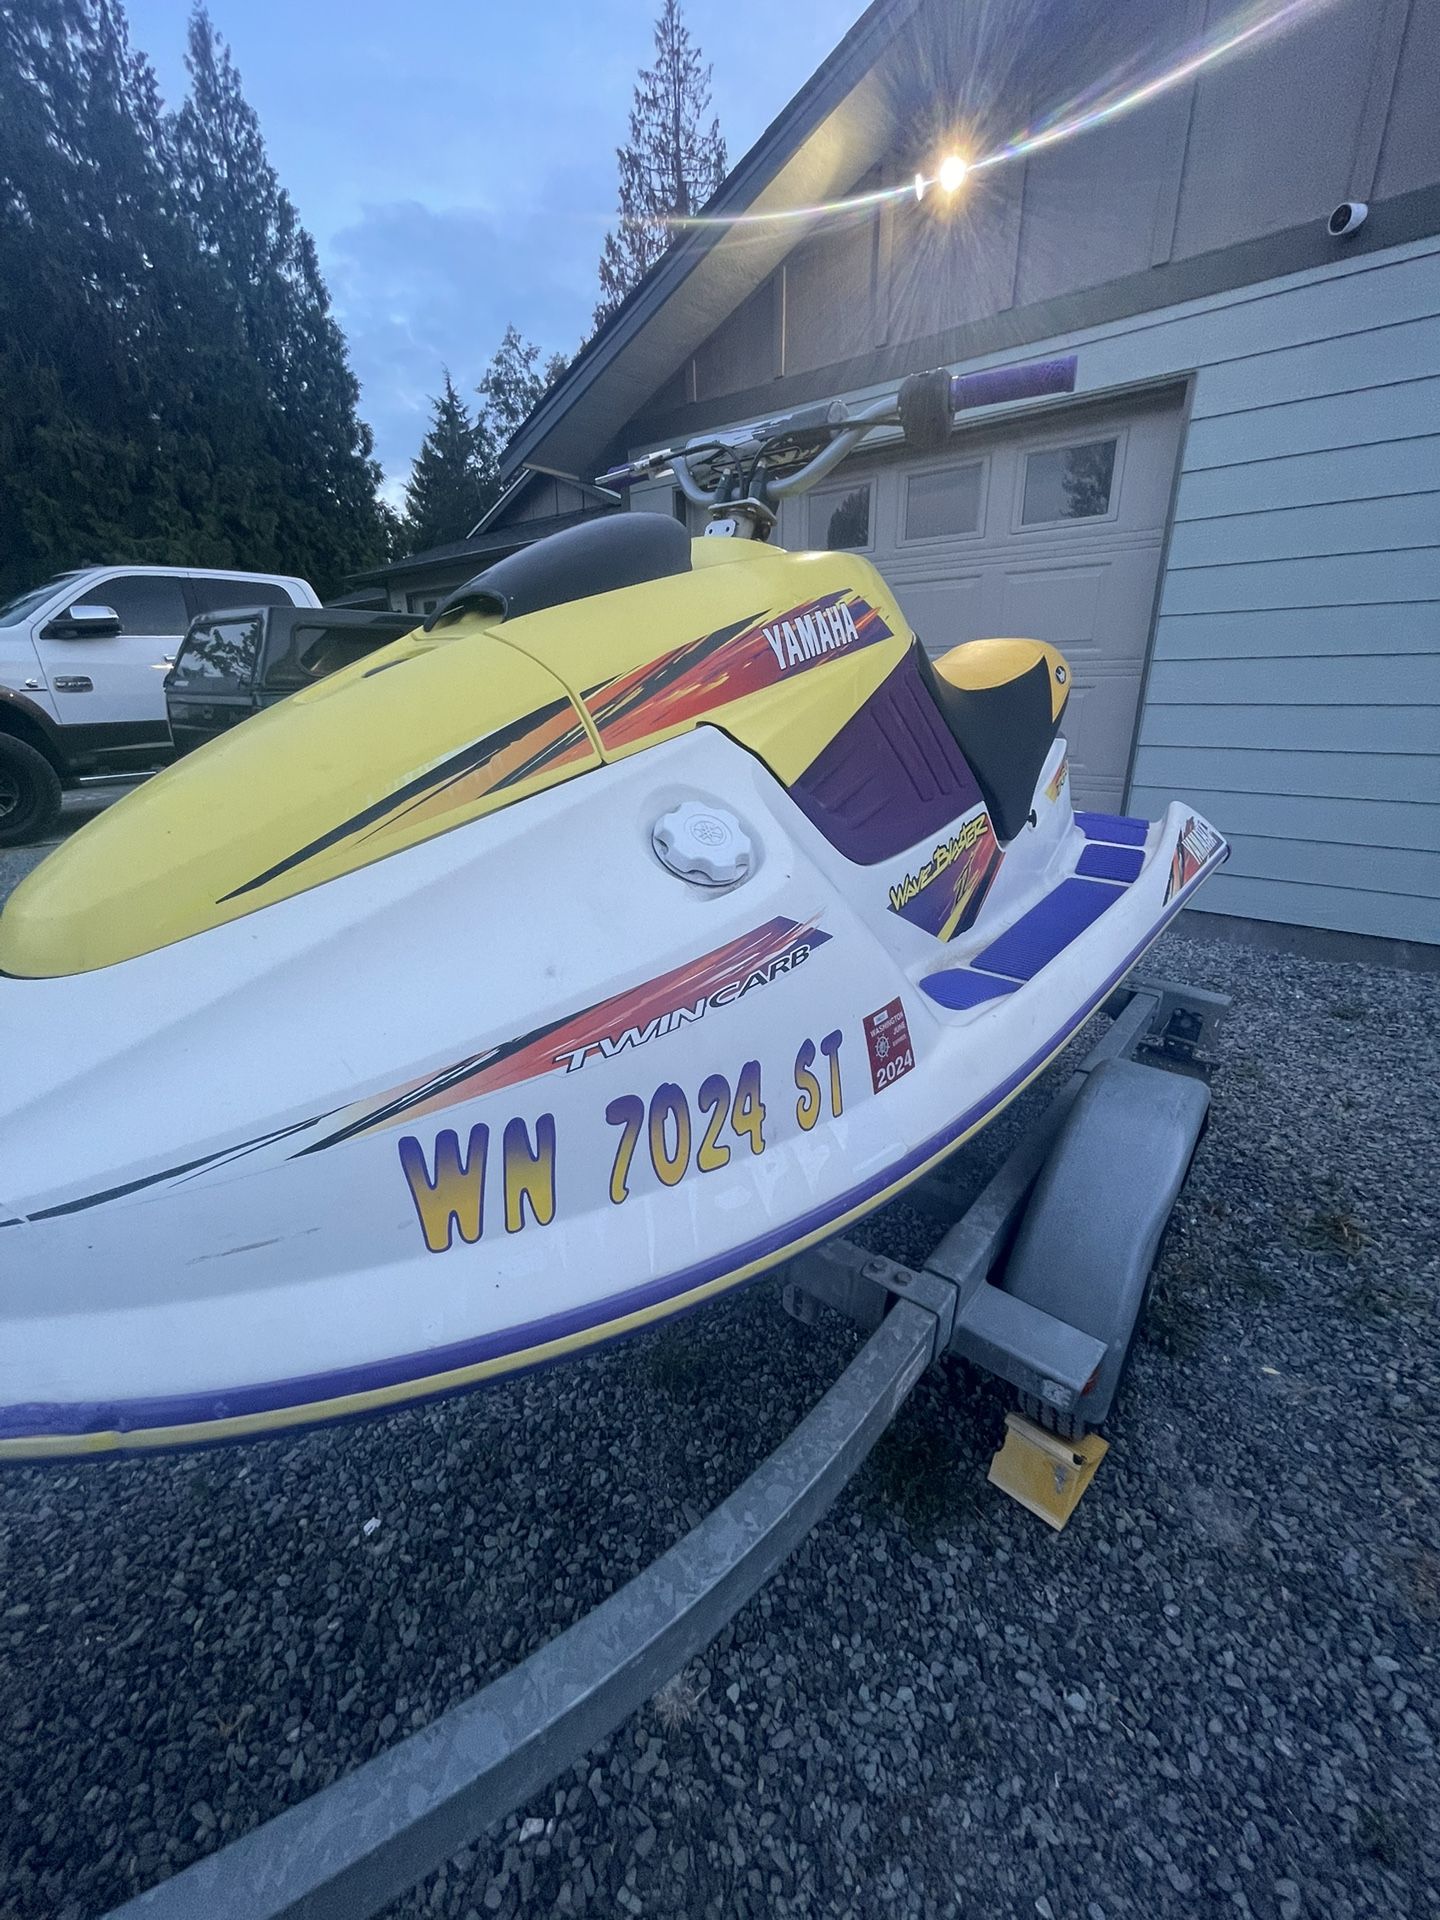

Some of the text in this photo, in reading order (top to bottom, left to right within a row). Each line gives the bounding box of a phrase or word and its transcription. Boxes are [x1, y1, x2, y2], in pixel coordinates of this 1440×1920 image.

[762, 602, 859, 670] YAMAHA
[877, 1049, 912, 1088] 2024
[398, 1029, 844, 1254] WN 7024 ST
